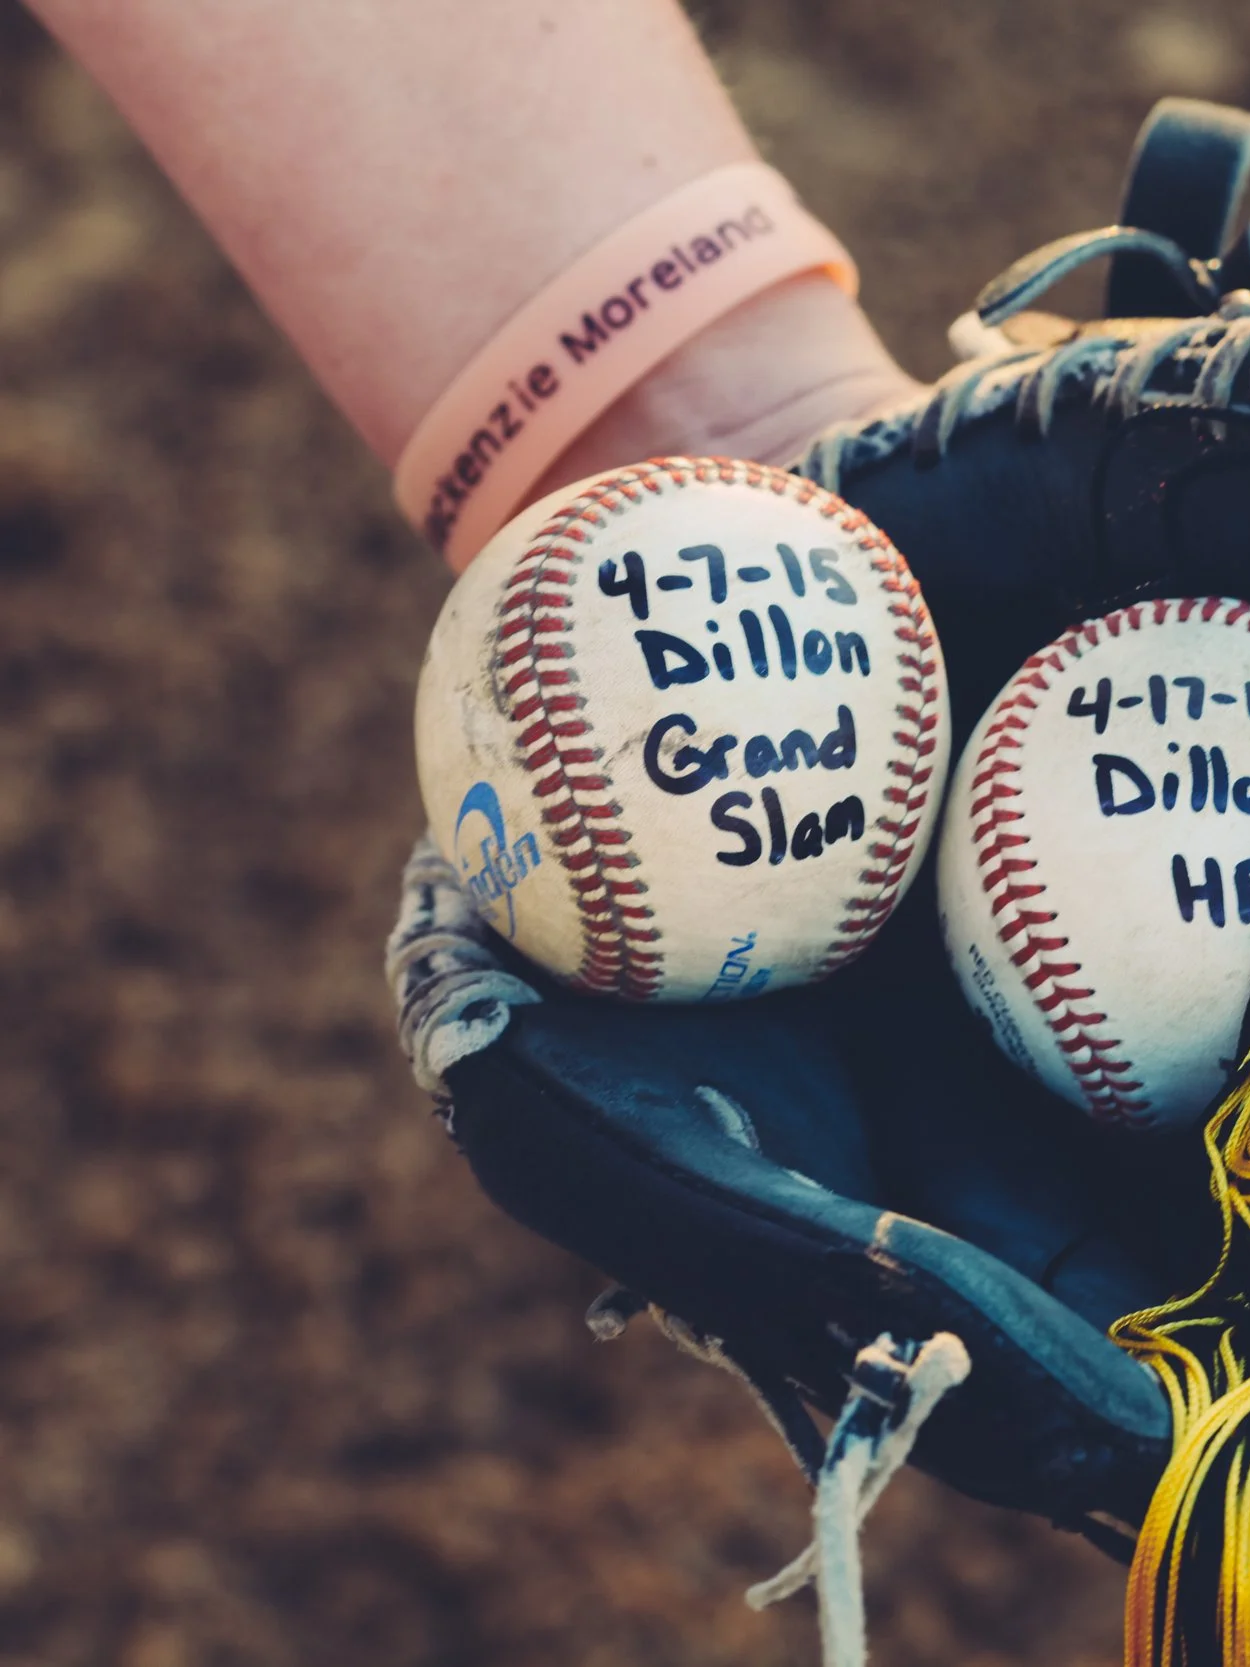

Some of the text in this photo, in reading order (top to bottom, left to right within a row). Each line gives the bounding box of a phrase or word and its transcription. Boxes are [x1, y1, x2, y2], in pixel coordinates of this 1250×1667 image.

[558, 205, 774, 364] Moreland
[598, 542, 858, 620] 4-7-15
[633, 603, 871, 690] Dillon
[643, 704, 857, 795] Grand
[710, 786, 866, 867] Slam
